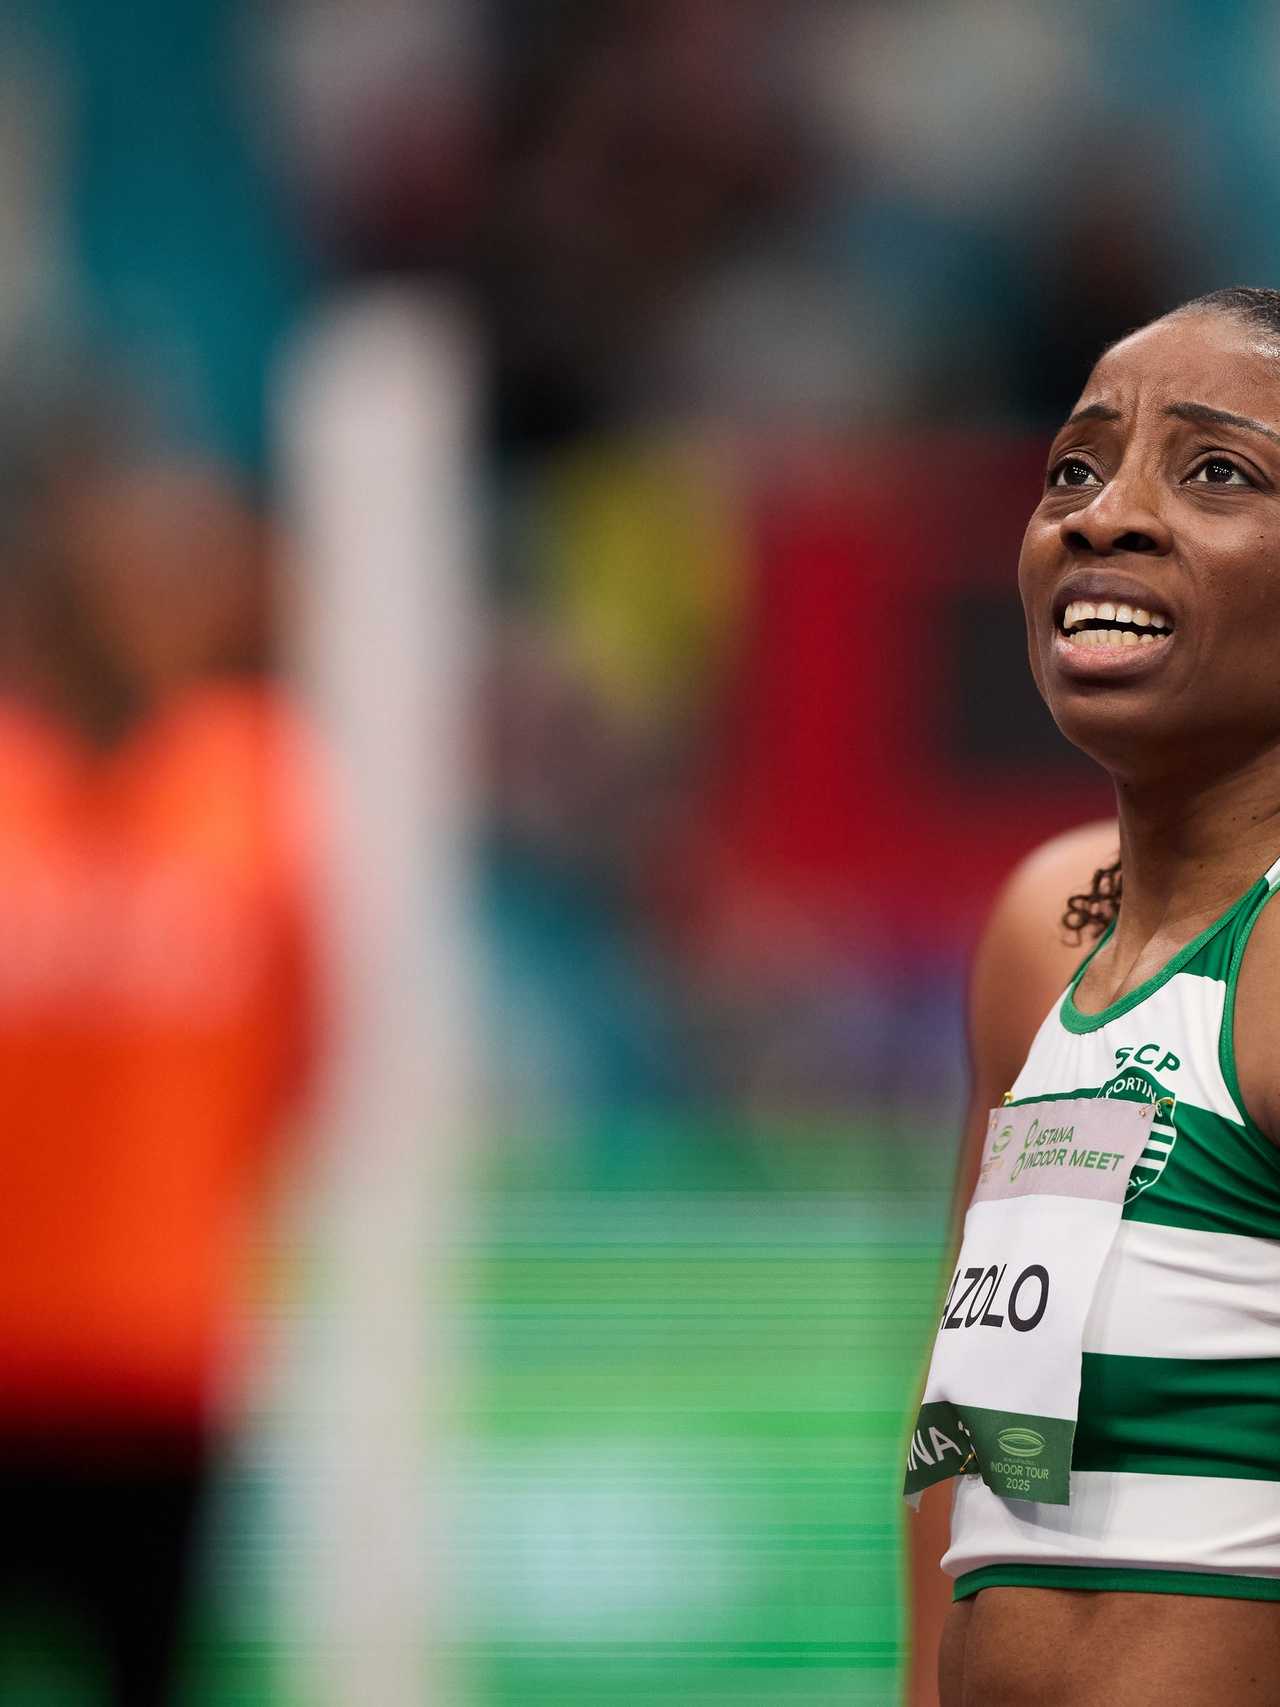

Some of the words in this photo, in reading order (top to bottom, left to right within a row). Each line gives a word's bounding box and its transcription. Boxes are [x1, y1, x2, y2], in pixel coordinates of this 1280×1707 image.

[1115, 1043, 1180, 1072] SCP
[1101, 1076, 1163, 1118] PORTING
[1033, 1126, 1074, 1147] ASTANA
[1023, 1148, 1068, 1169] INDOOR
[1069, 1149, 1125, 1171] MEET
[990, 1461, 1024, 1476] INDOOR
[1025, 1466, 1049, 1479] TOUR
[1006, 1477, 1031, 1491] 2025
